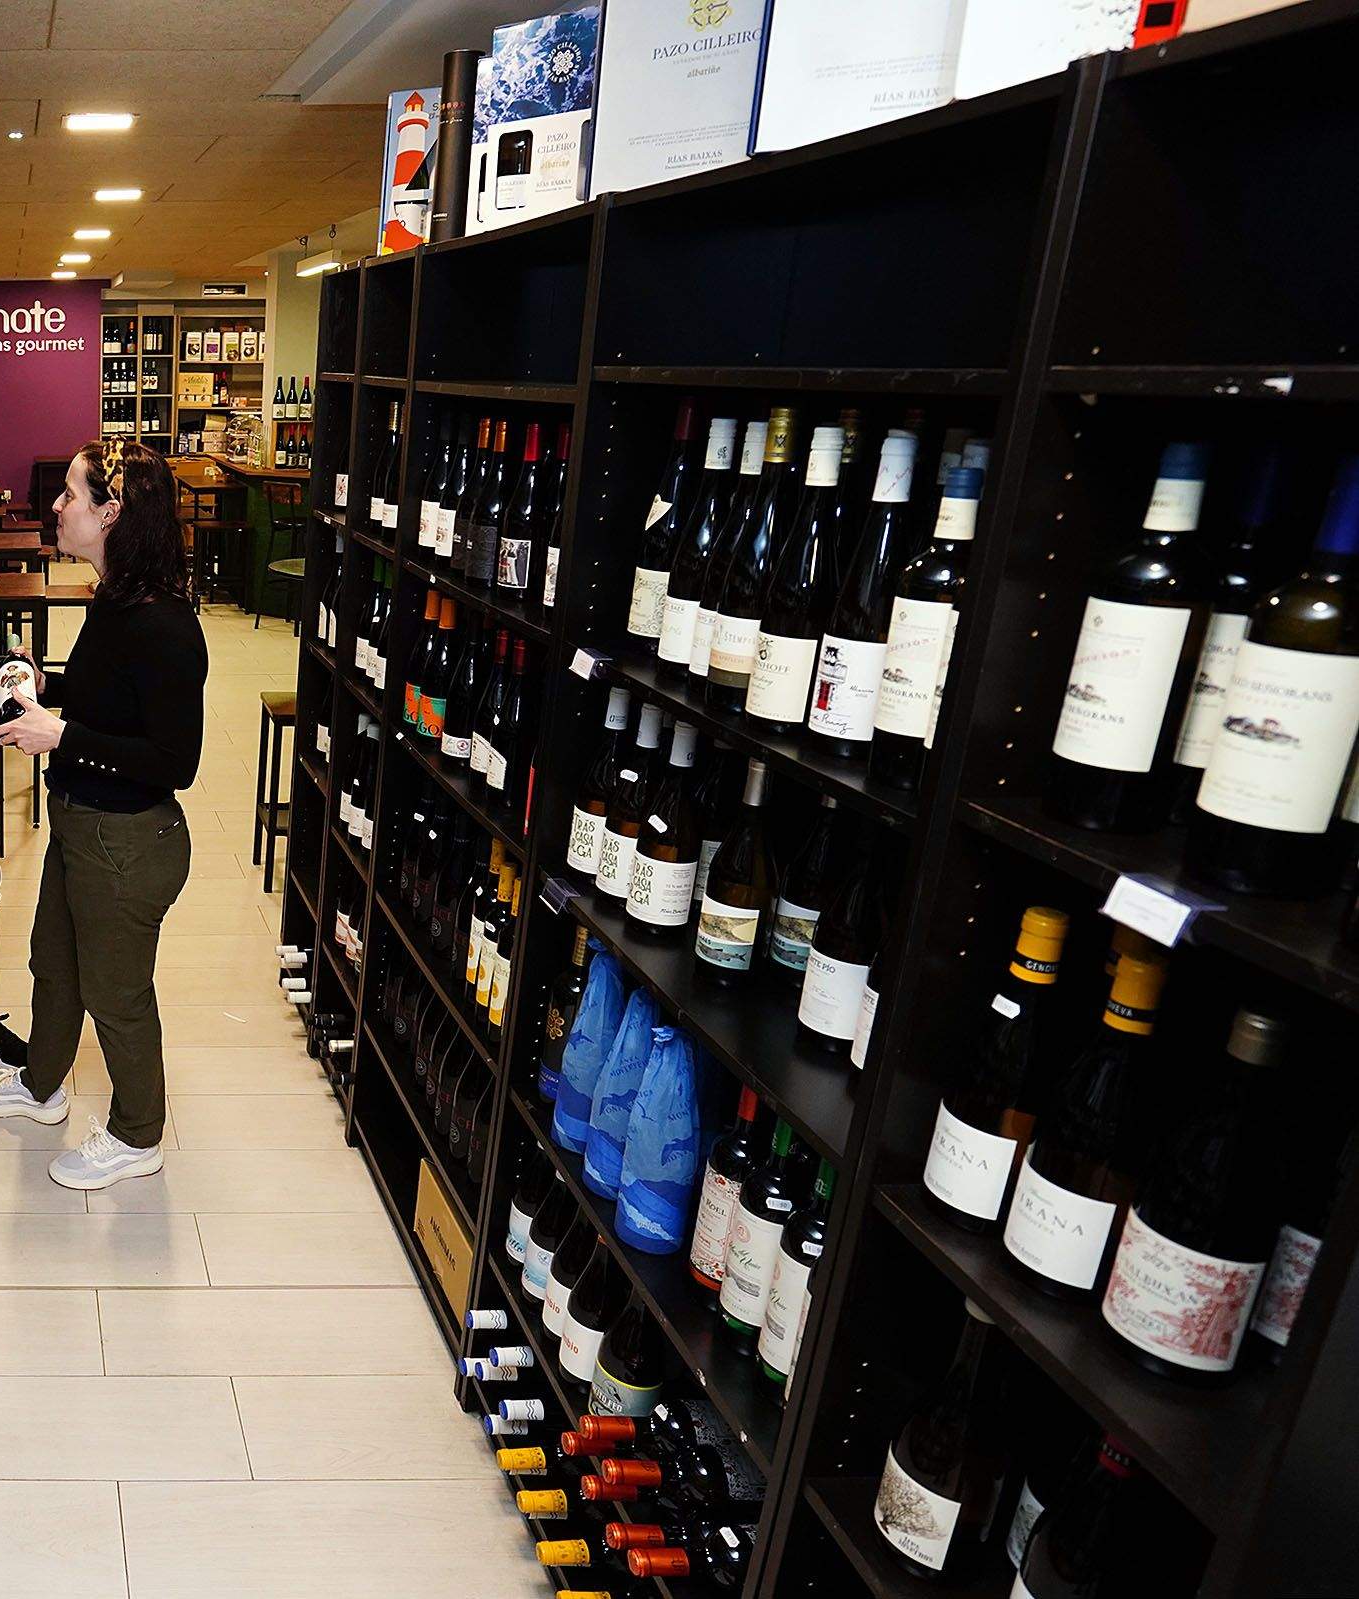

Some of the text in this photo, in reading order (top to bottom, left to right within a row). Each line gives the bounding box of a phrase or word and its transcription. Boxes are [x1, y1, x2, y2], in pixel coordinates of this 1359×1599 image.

[652, 42, 690, 61] PAZO
[693, 28, 763, 53] CILLEIRO
[690, 149, 723, 161] BAIXAS
[15, 336, 85, 357] gourmet
